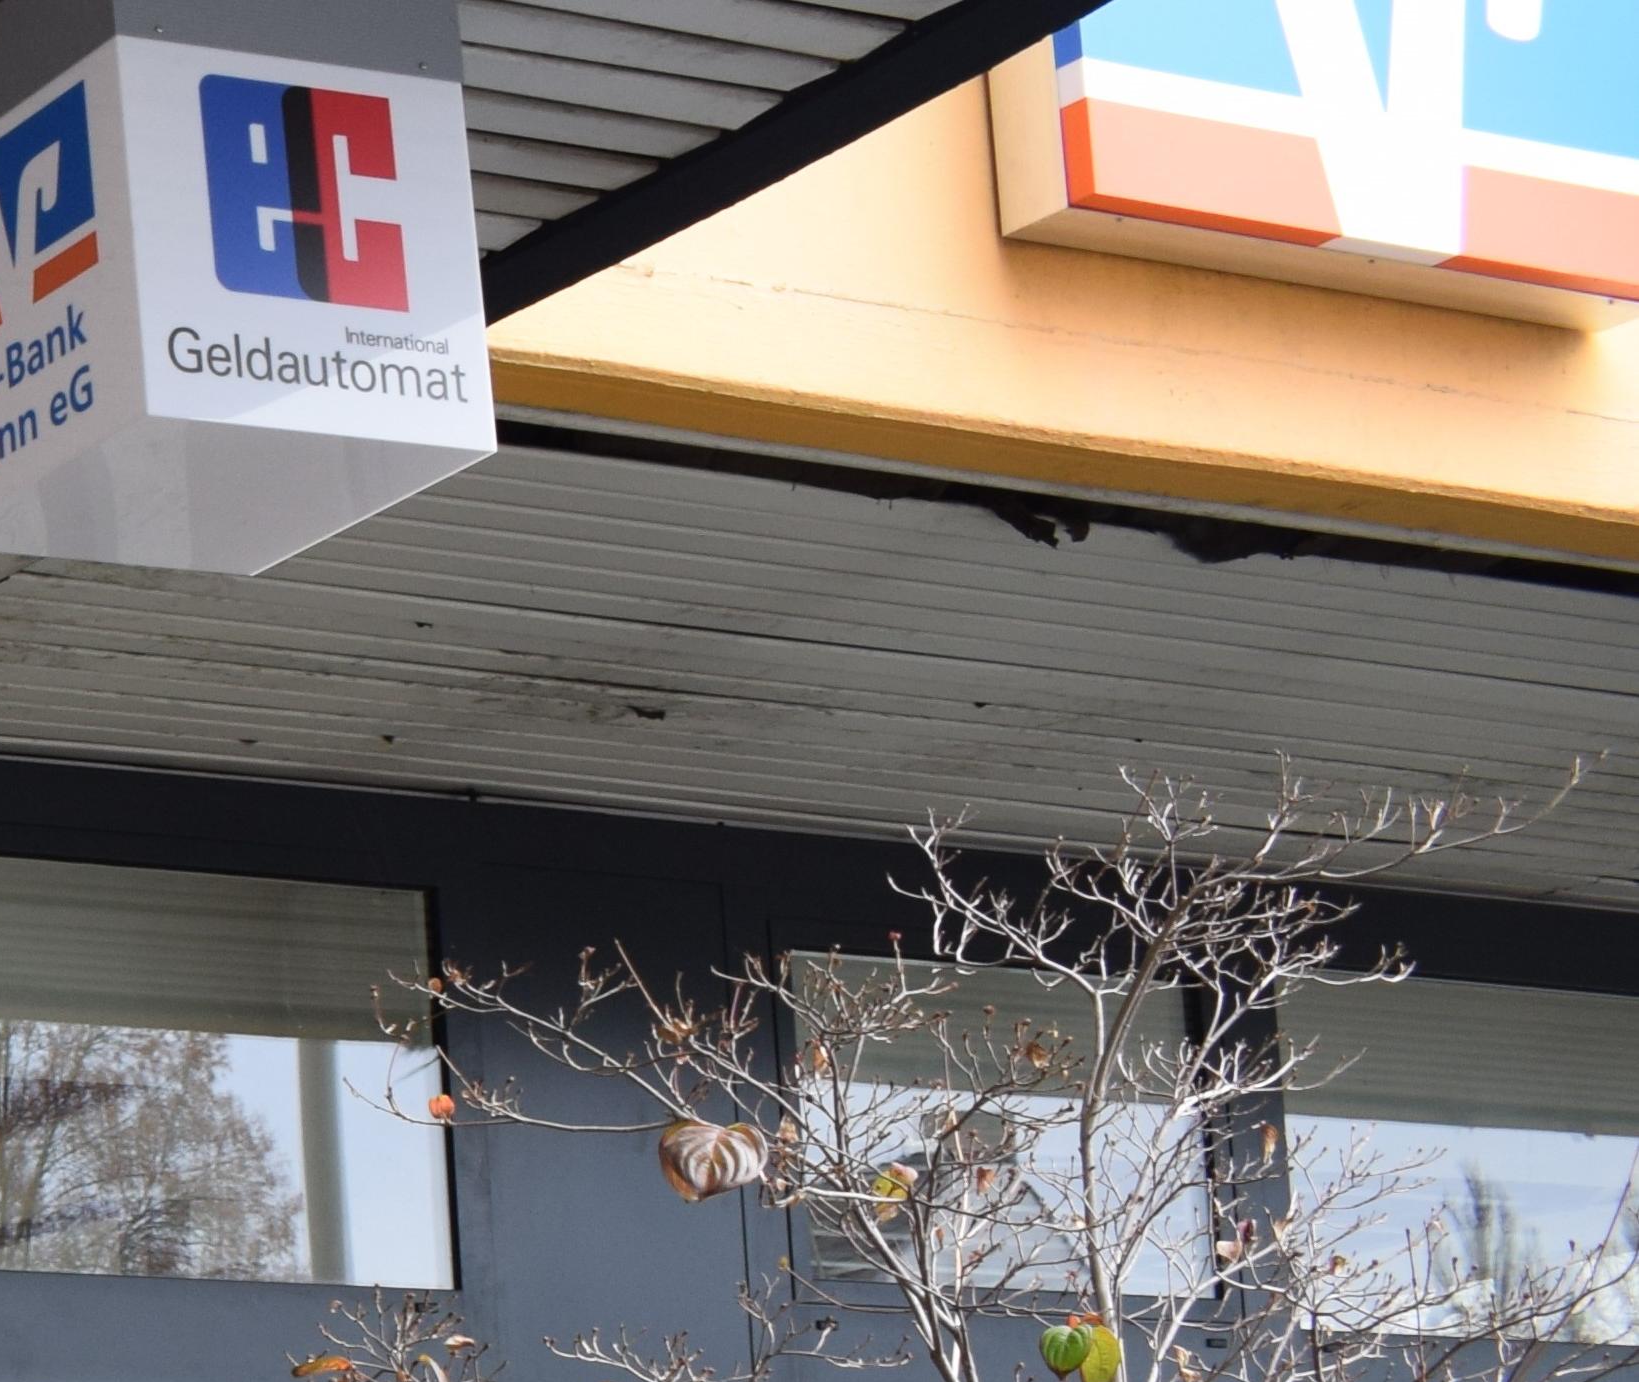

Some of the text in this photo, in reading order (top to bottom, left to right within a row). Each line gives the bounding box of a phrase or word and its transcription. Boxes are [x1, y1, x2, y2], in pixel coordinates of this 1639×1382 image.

[167, 326, 469, 404] Geldautomat
[346, 328, 449, 355] International
[49, 365, 95, 431] eG
